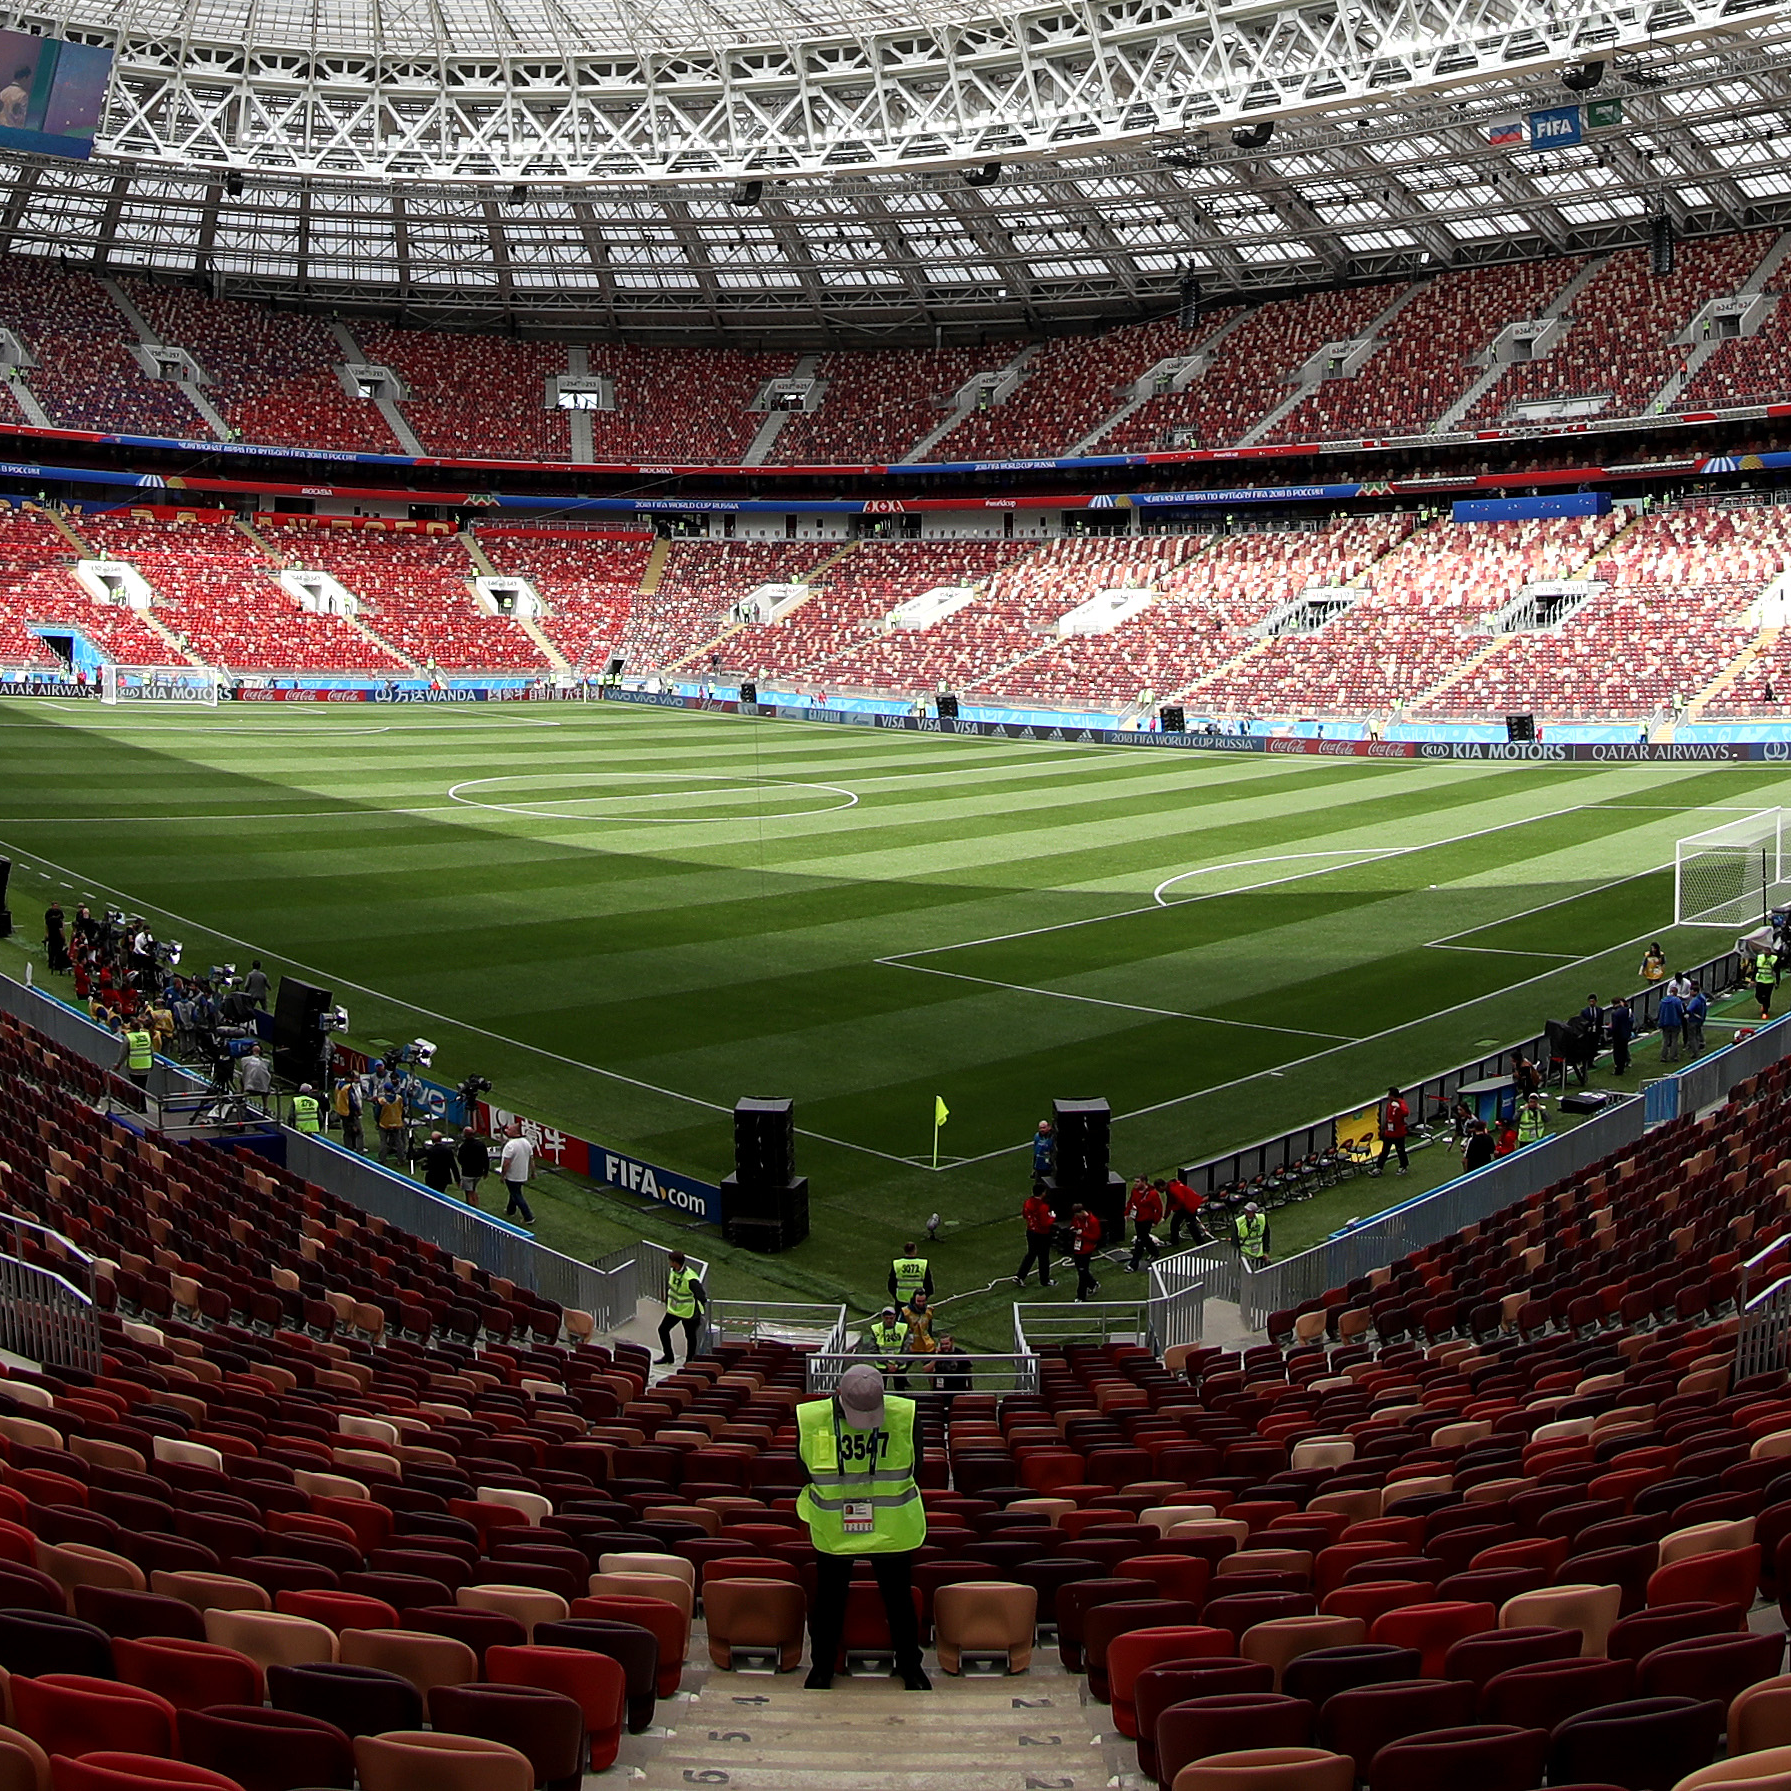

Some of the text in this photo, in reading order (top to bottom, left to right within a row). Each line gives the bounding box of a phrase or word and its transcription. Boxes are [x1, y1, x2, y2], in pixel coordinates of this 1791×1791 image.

[1536, 118, 1573, 139] FIFA
[669, 501, 695, 509] WORLD
[695, 501, 711, 509] CUP
[712, 502, 739, 510] RUSSIA
[37, 684, 95, 697] AIRWAYS
[141, 686, 167, 700] KIA
[285, 689, 317, 701] Coca-Cola
[425, 689, 476, 701] WANDA
[881, 715, 979, 735] VISA VISA VISA
[1111, 732, 1254, 750] 2018 FIFA WORLD CUP RUSSIA
[1270, 738, 1406, 756] Coca-Cola Coca-Cola Coca-Cola
[1452, 744, 1483, 759] KIA
[1488, 744, 1566, 760] MOTORS
[1592, 744, 1729, 762] QATAR AIRWAYS
[841, 1431, 890, 1461] 3547
